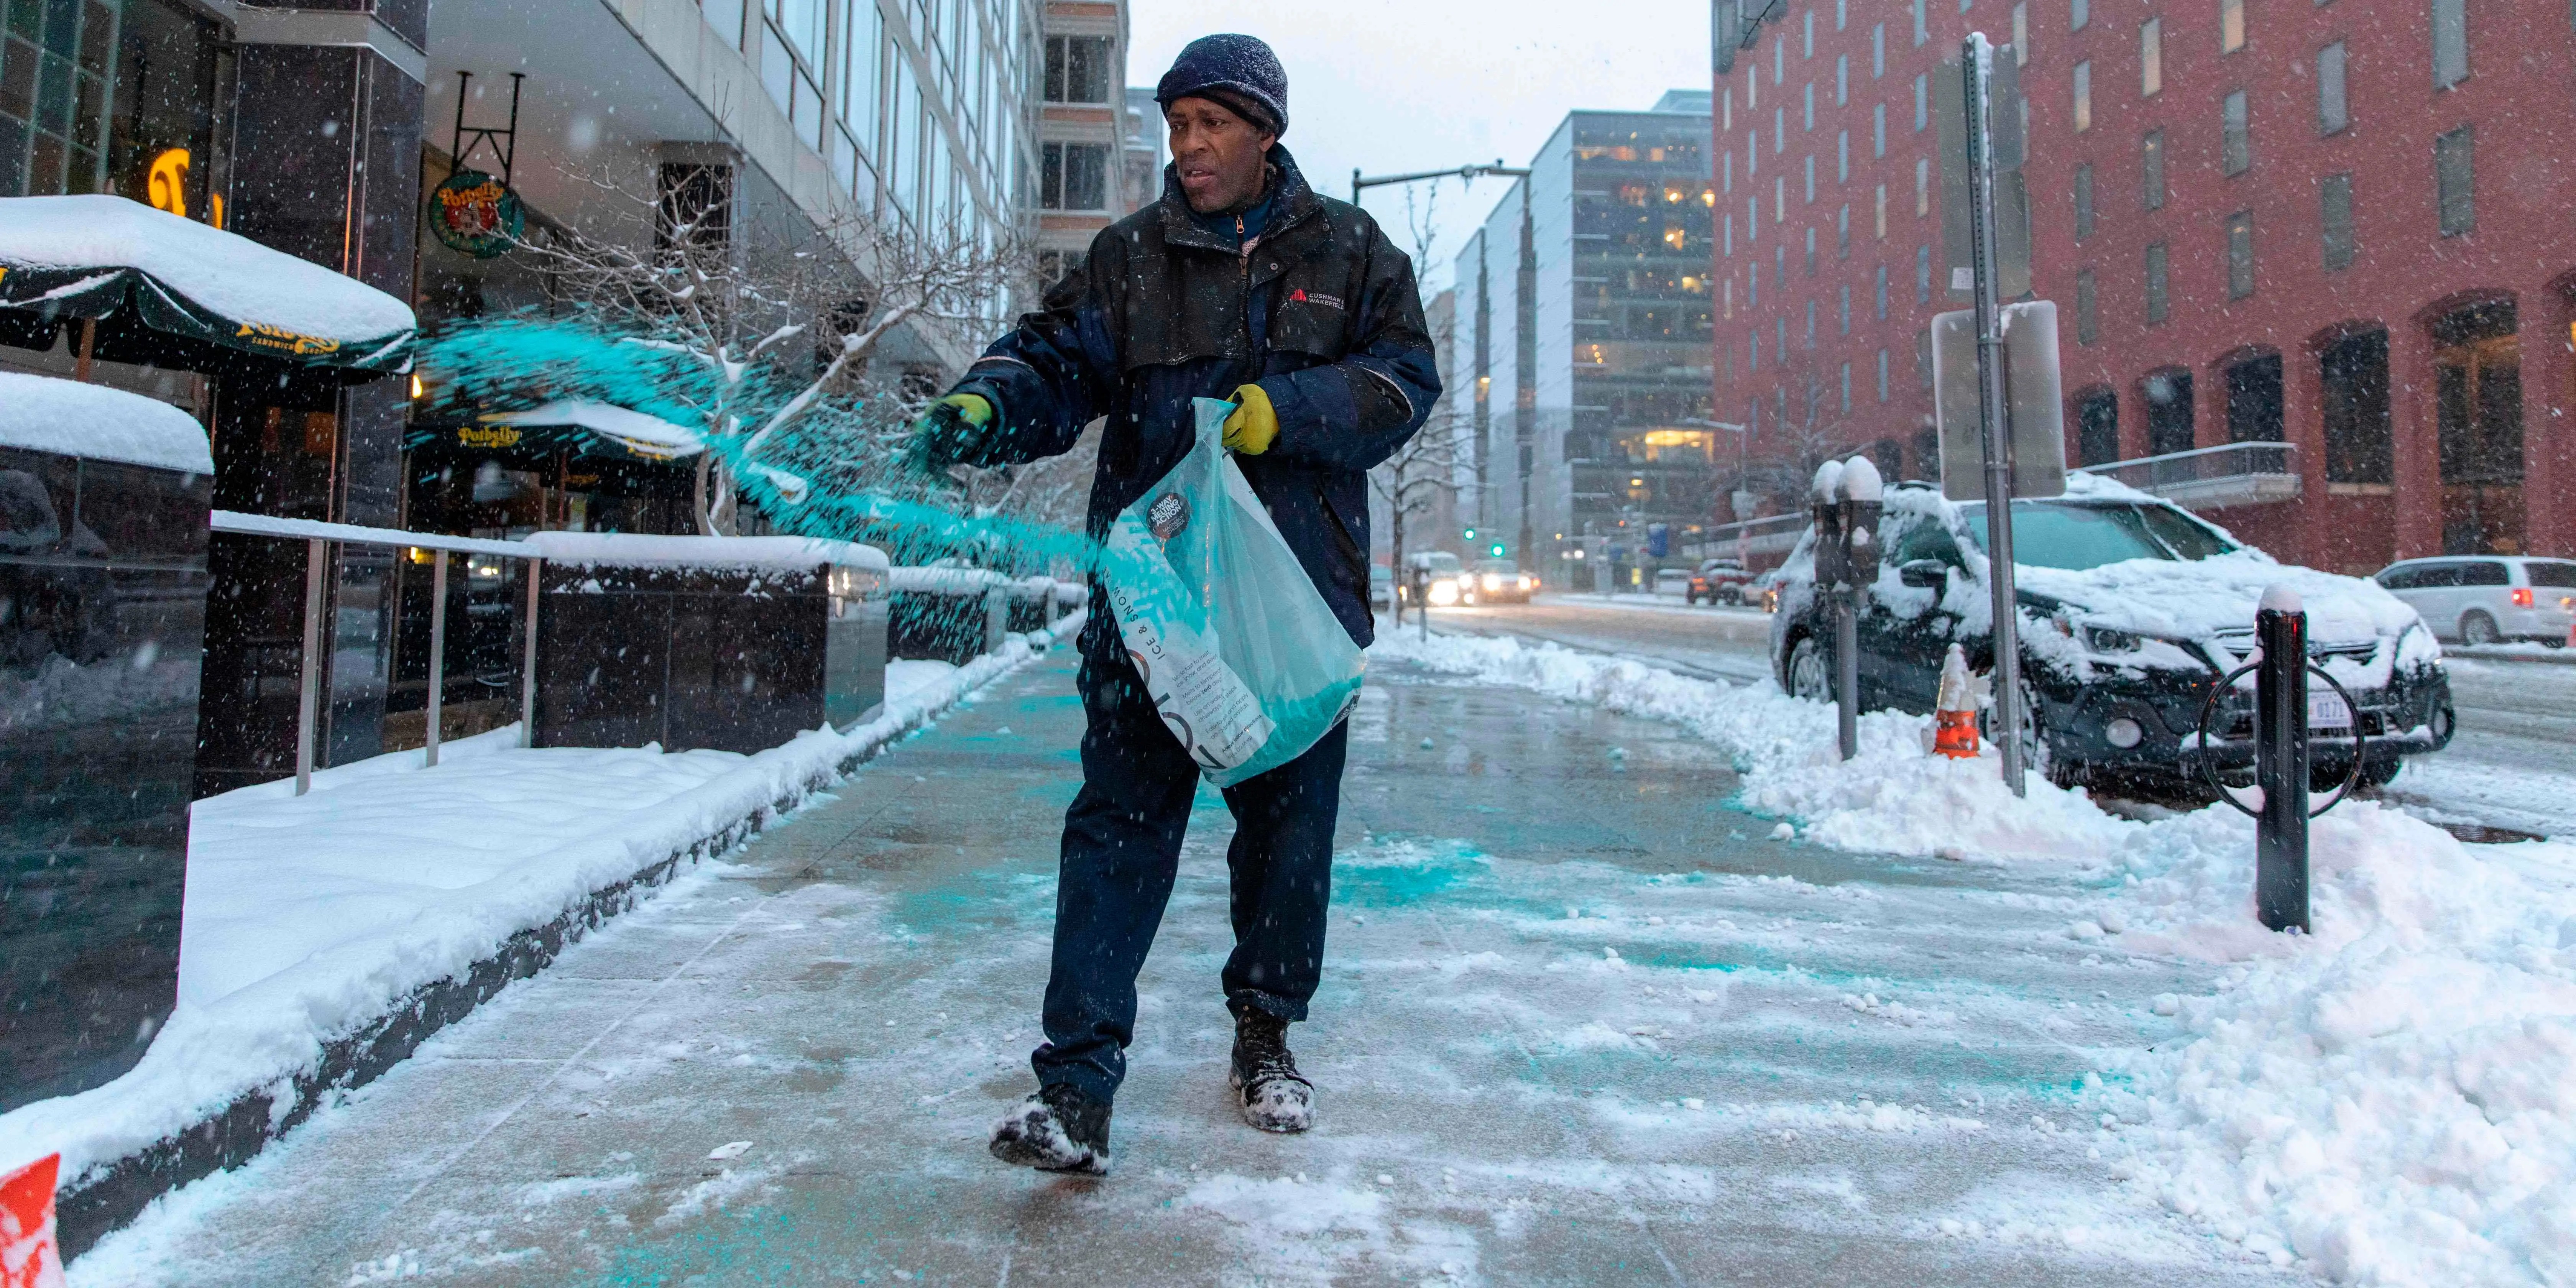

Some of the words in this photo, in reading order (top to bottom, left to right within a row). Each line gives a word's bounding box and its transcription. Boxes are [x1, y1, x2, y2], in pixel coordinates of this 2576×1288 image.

[1309, 293, 1341, 303] CUSHMAN
[1309, 298, 1344, 310] WAKEFIELD
[457, 426, 521, 448] Potbelly
[1151, 495, 1173, 514] 3-WAY
[1151, 499, 1178, 522] MELTING
[1156, 504, 1181, 527] ACTION
[1162, 513, 1185, 532] MAGNESIUM
[1138, 624, 1147, 634] &
[1146, 637, 1165, 660] ICE
[1197, 662, 1207, 672] and
[1201, 684, 1212, 694] zero
